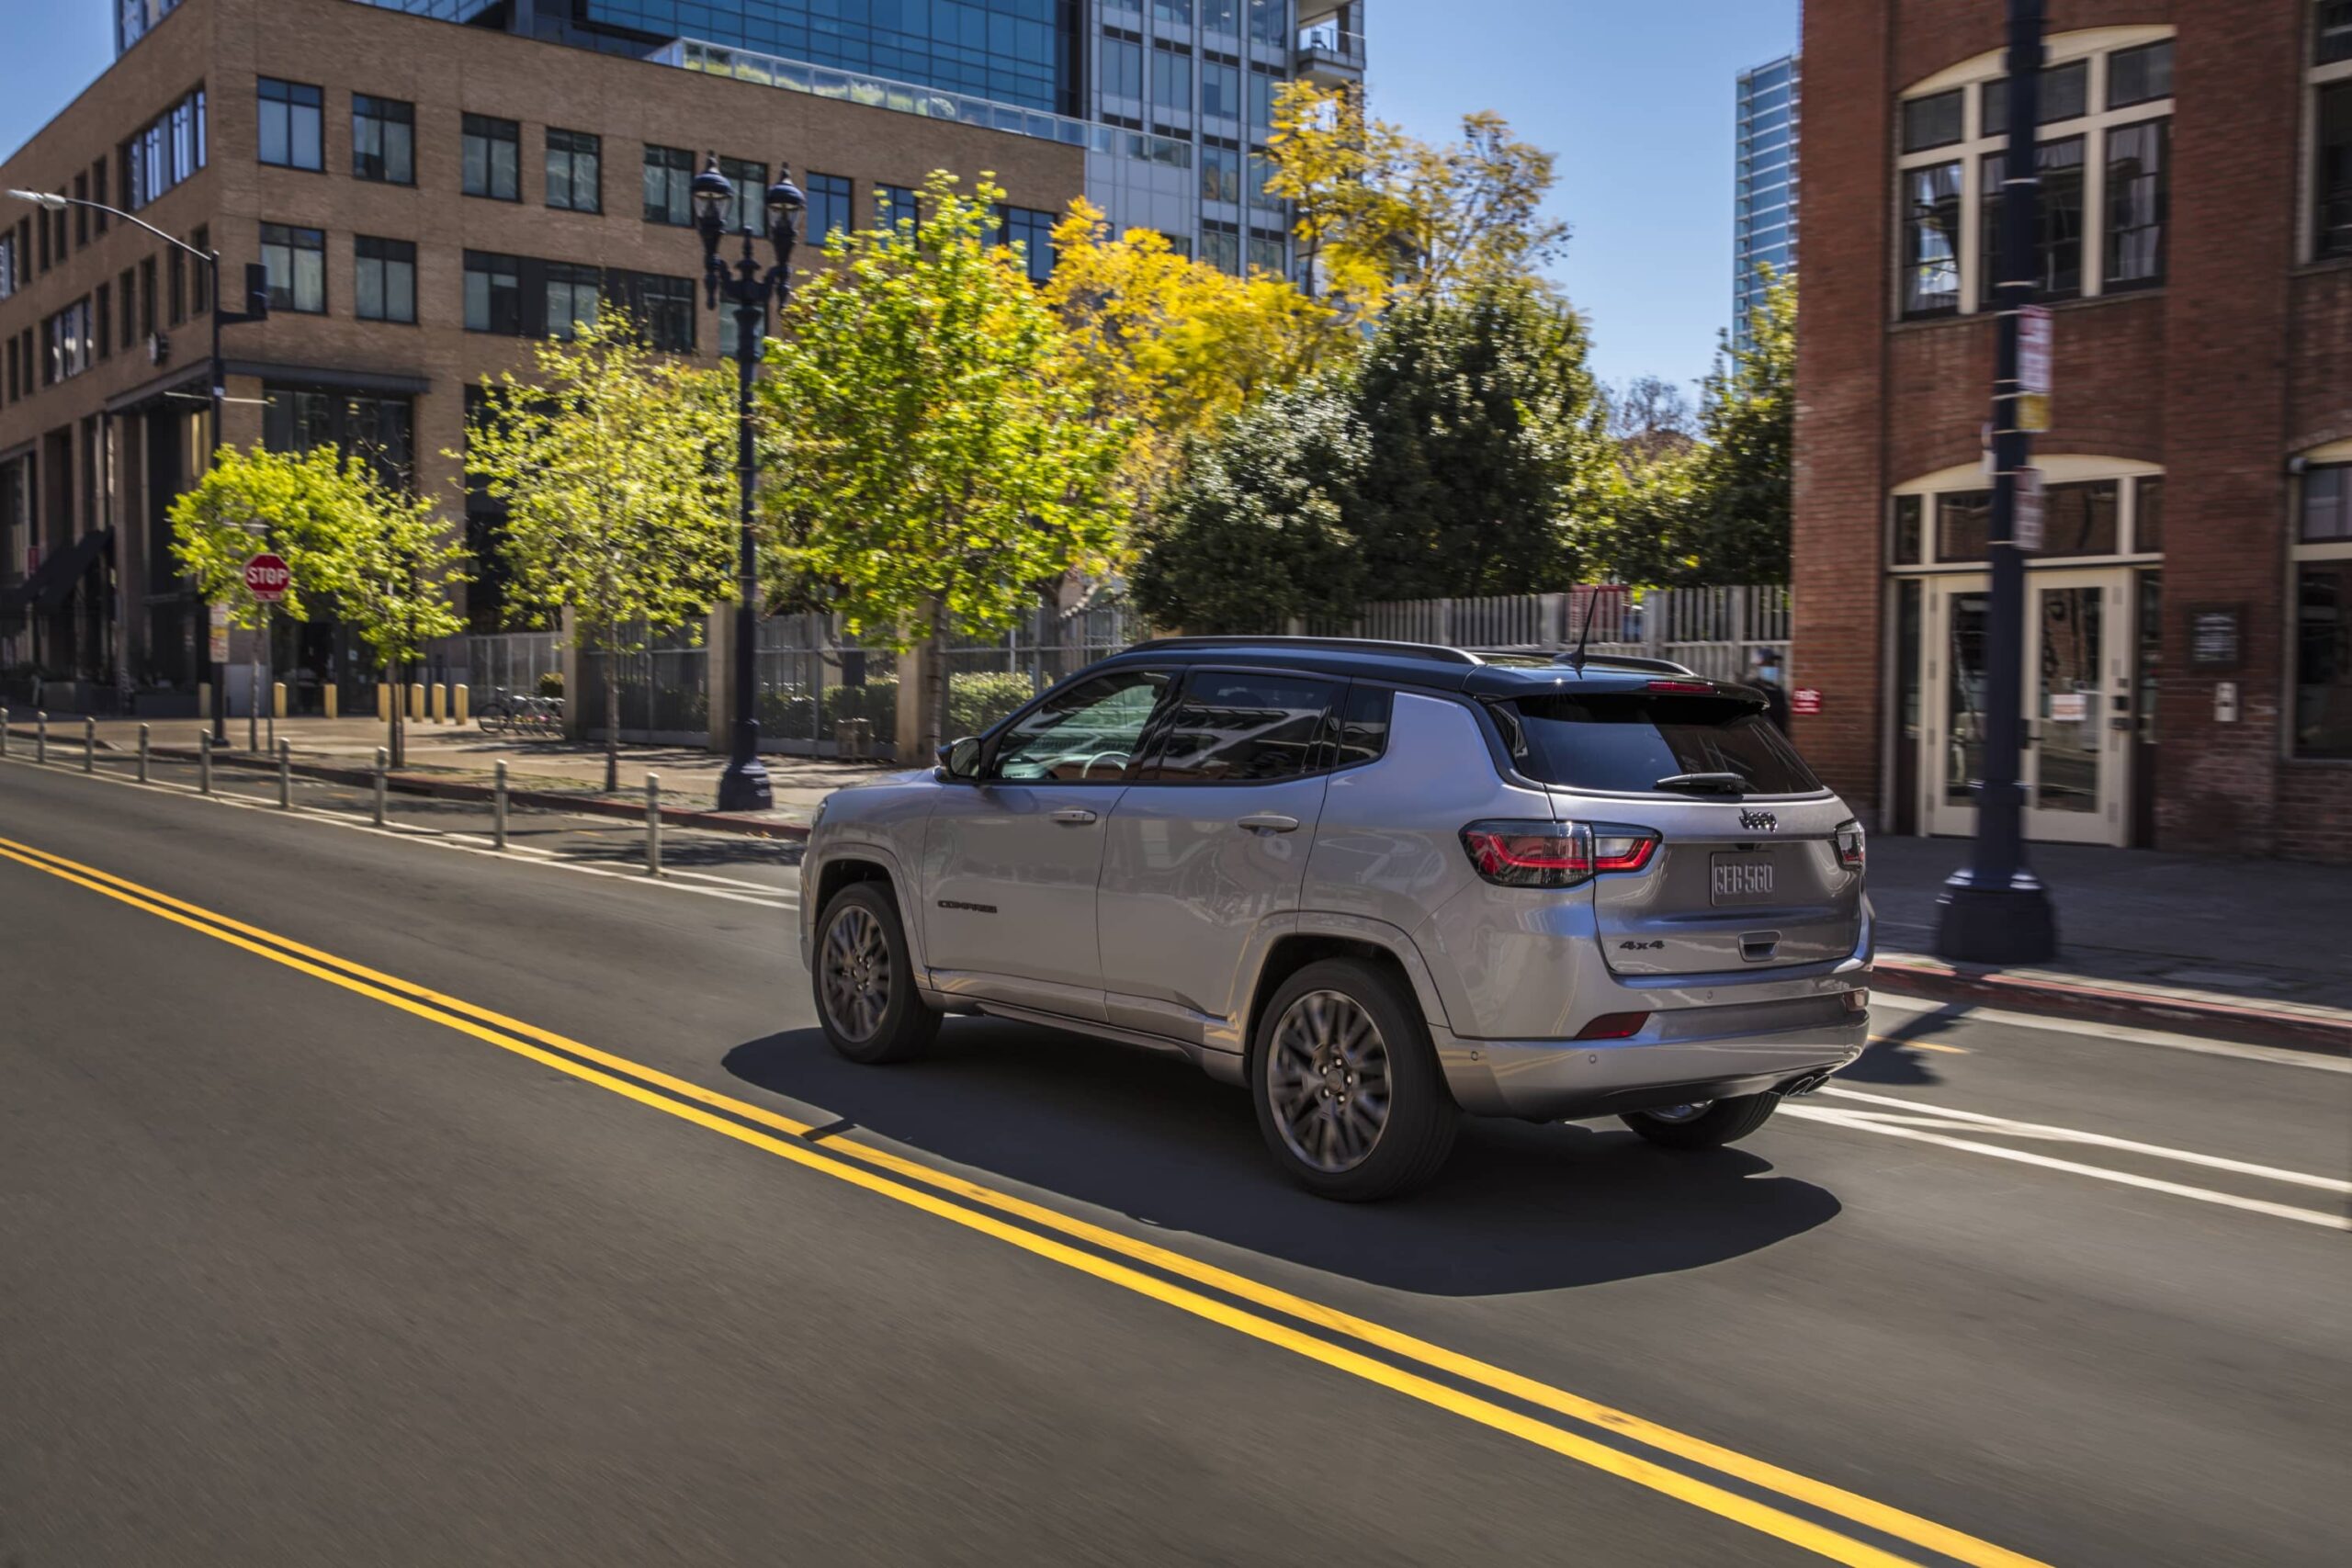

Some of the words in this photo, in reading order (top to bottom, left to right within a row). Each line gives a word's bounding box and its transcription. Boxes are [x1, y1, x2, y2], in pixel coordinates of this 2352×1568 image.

[247, 567, 288, 585] STOP
[1738, 808, 1778, 832] Jeep
[1619, 940, 1665, 950] 4x4
